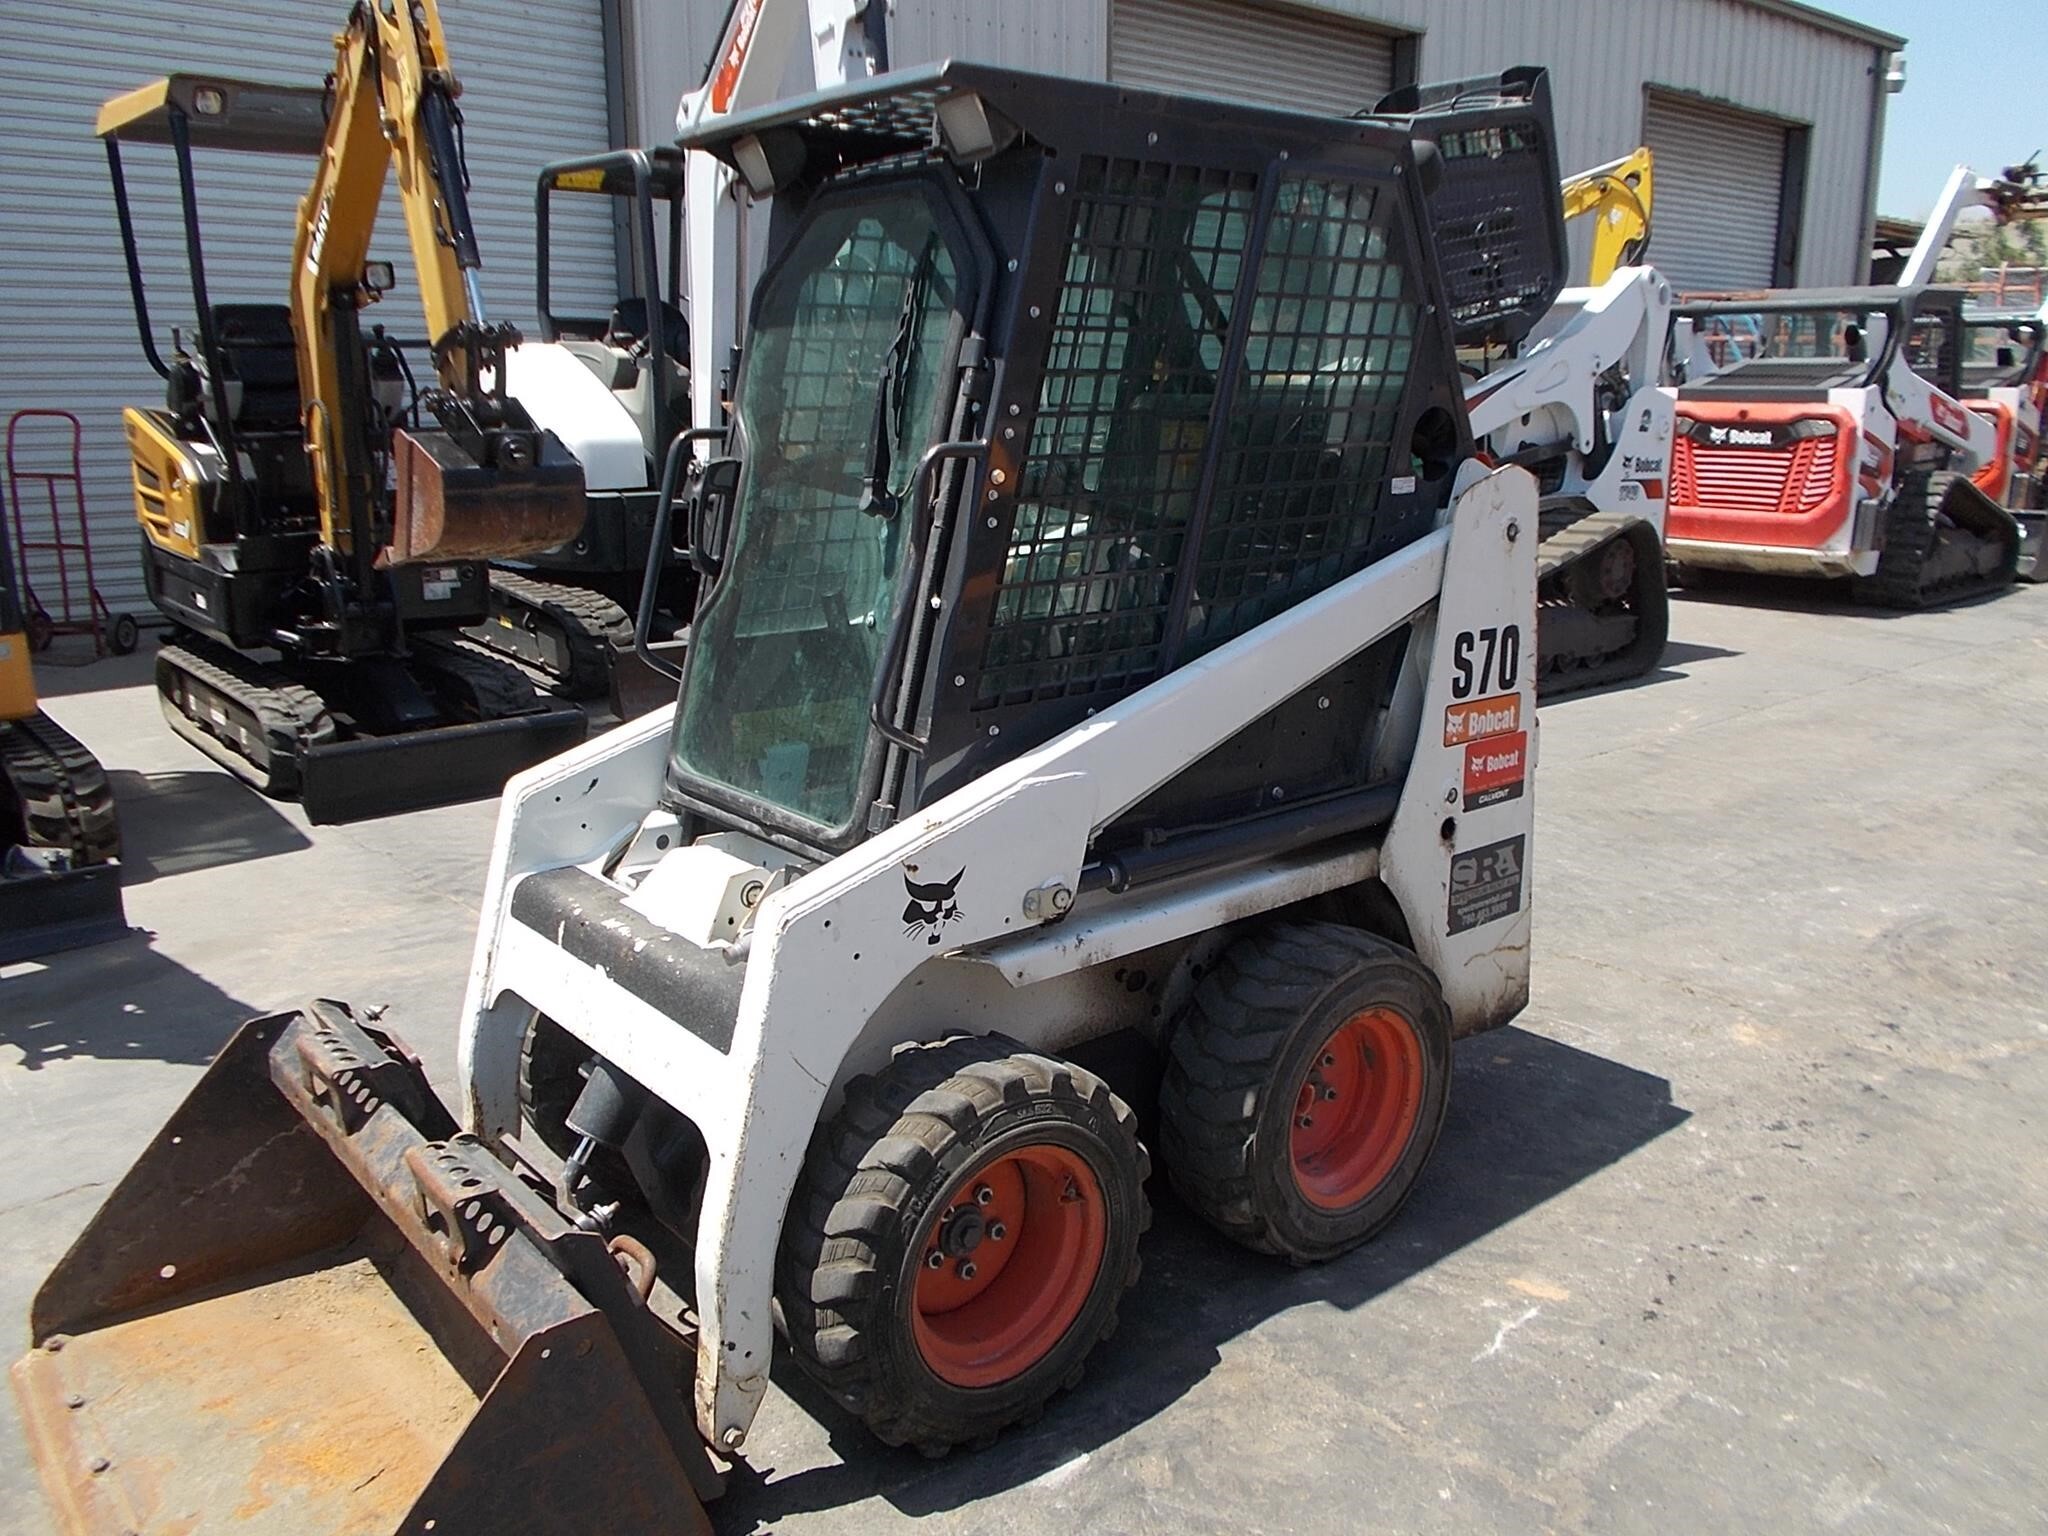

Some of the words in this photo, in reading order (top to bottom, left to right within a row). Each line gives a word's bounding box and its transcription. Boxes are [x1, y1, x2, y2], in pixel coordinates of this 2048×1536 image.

[1729, 429, 1772, 444] Bobcat
[1635, 457, 1663, 473] Bobcat
[1452, 624, 1520, 699] S70
[1469, 705, 1516, 736] Bobcat
[1487, 750, 1519, 773] Bobcat
